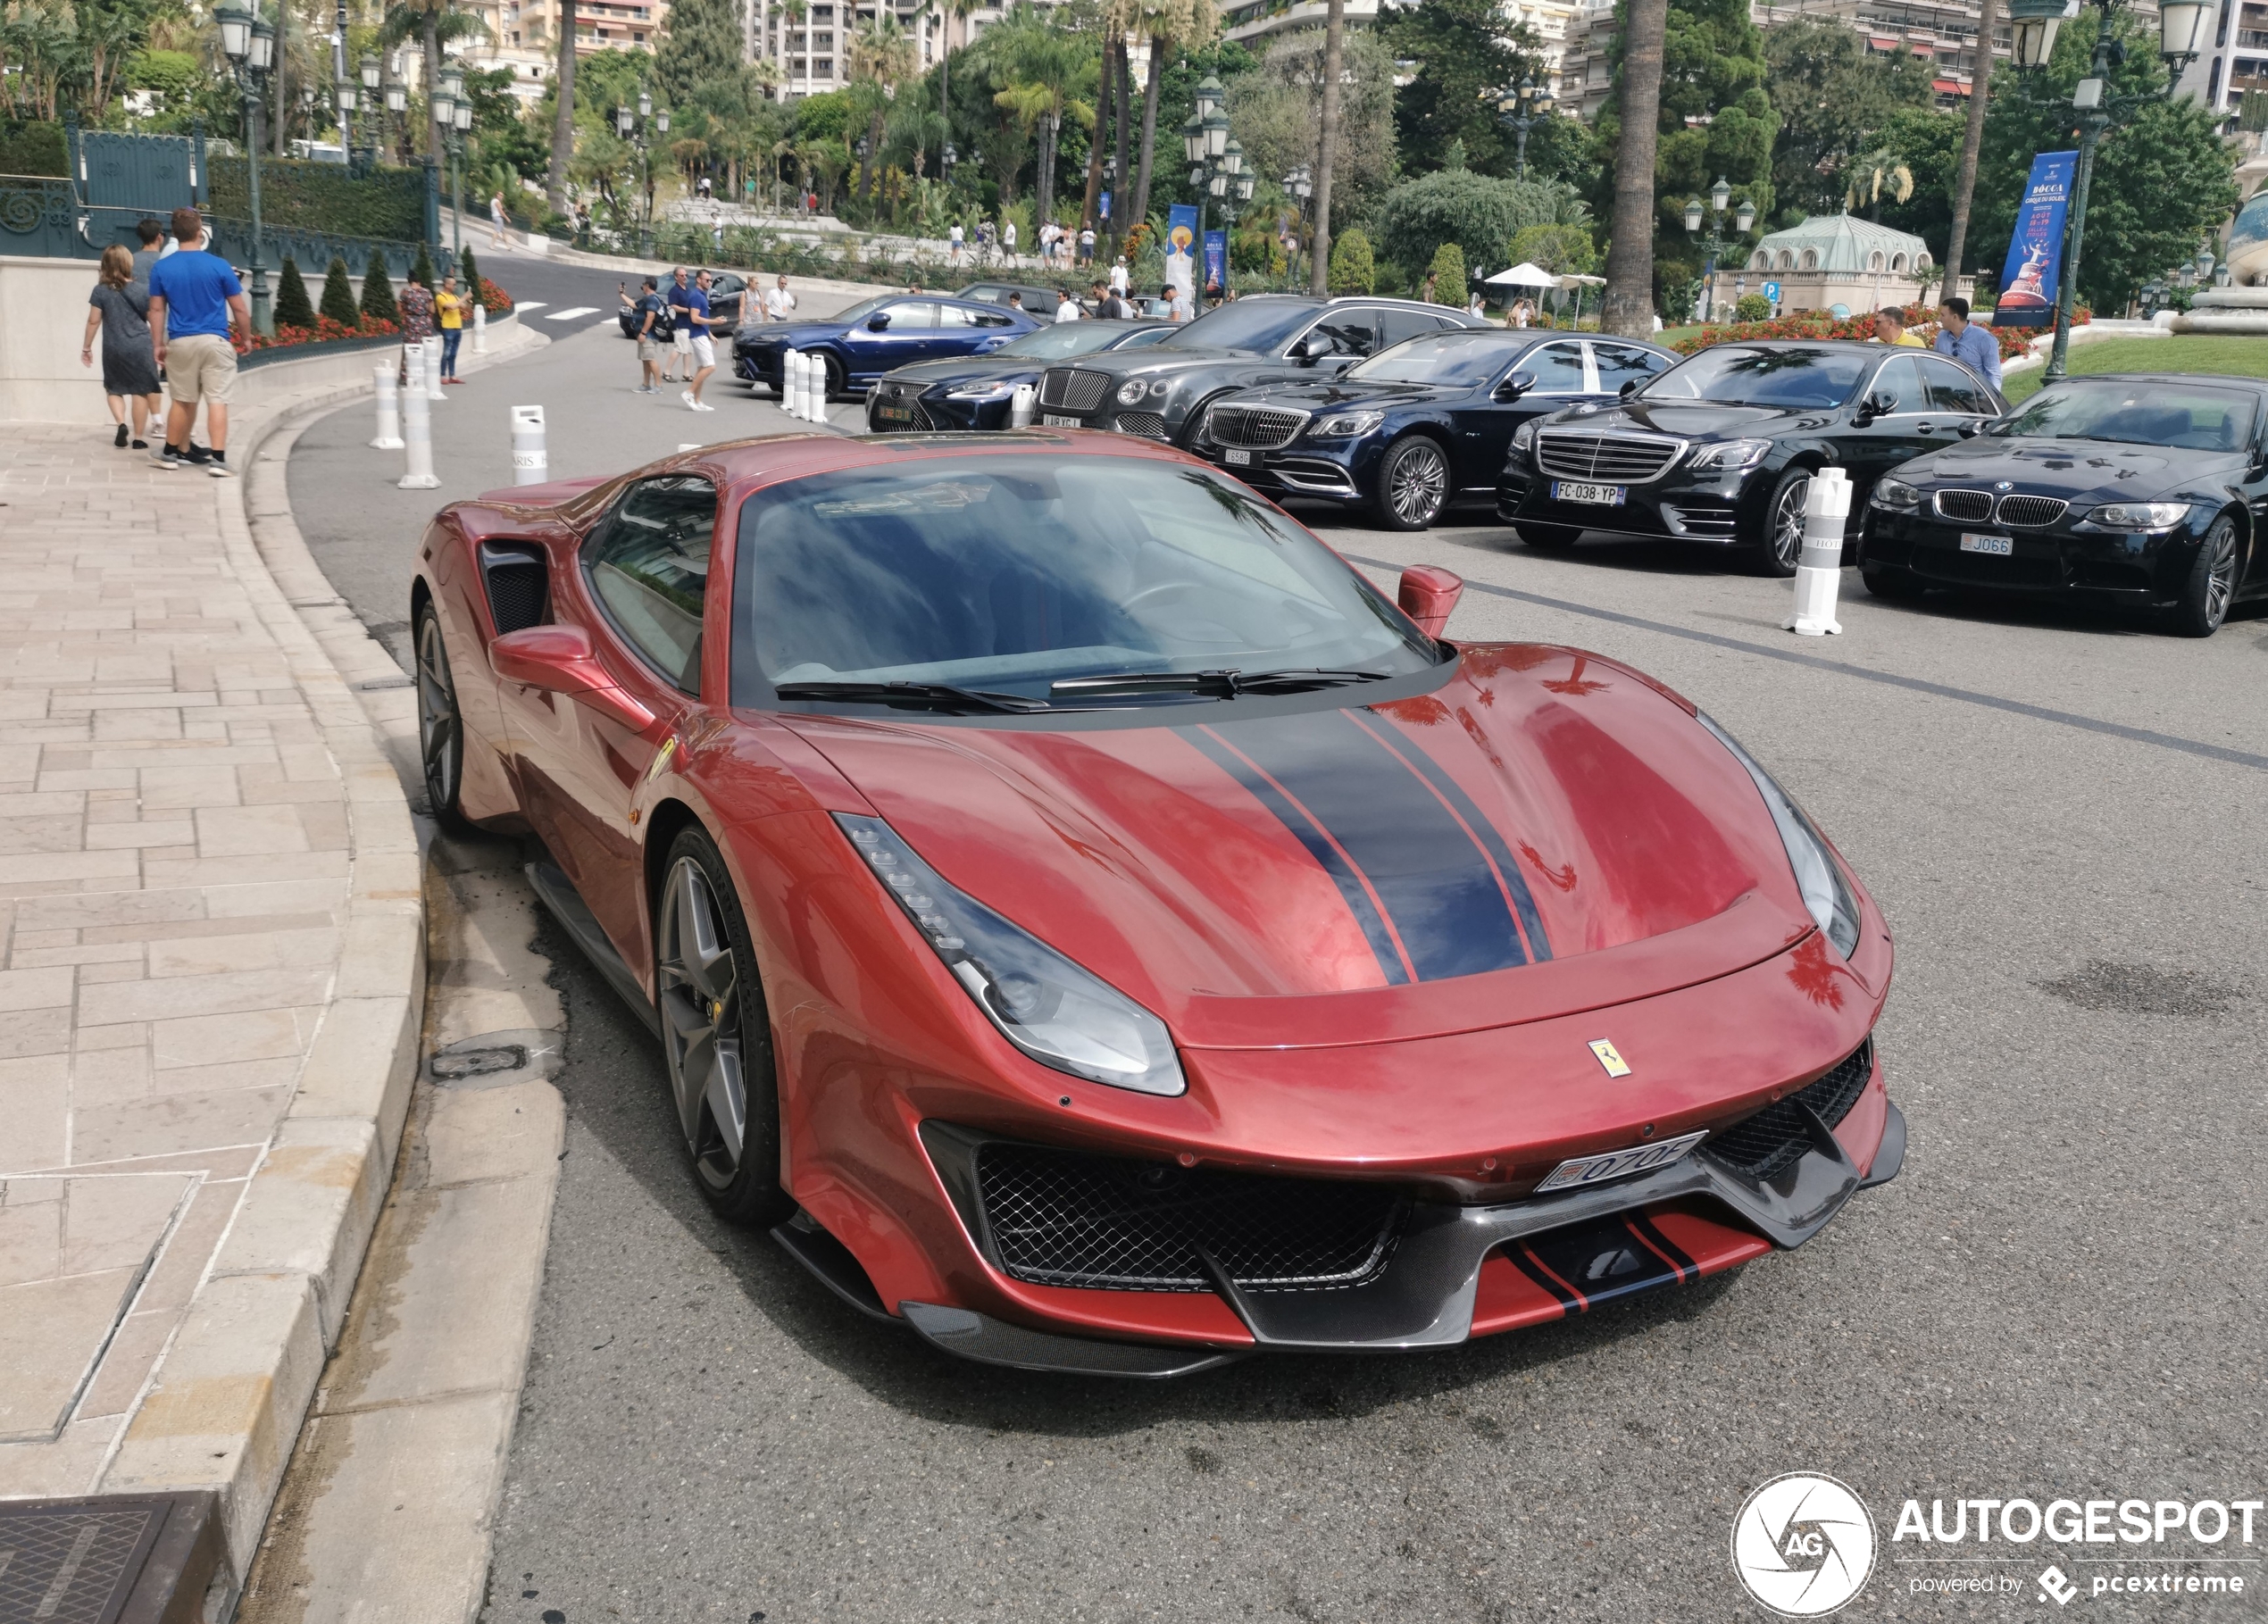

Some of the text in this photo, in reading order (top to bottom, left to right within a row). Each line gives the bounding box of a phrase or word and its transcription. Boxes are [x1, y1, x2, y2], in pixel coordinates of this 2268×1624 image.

[1768, 284, 1775, 296] P
[1231, 452, 1248, 463] 658G
[1558, 483, 1616, 502] FC-038-YP
[1973, 537, 2009, 553] J066
[1581, 1137, 1697, 1180] 070F
